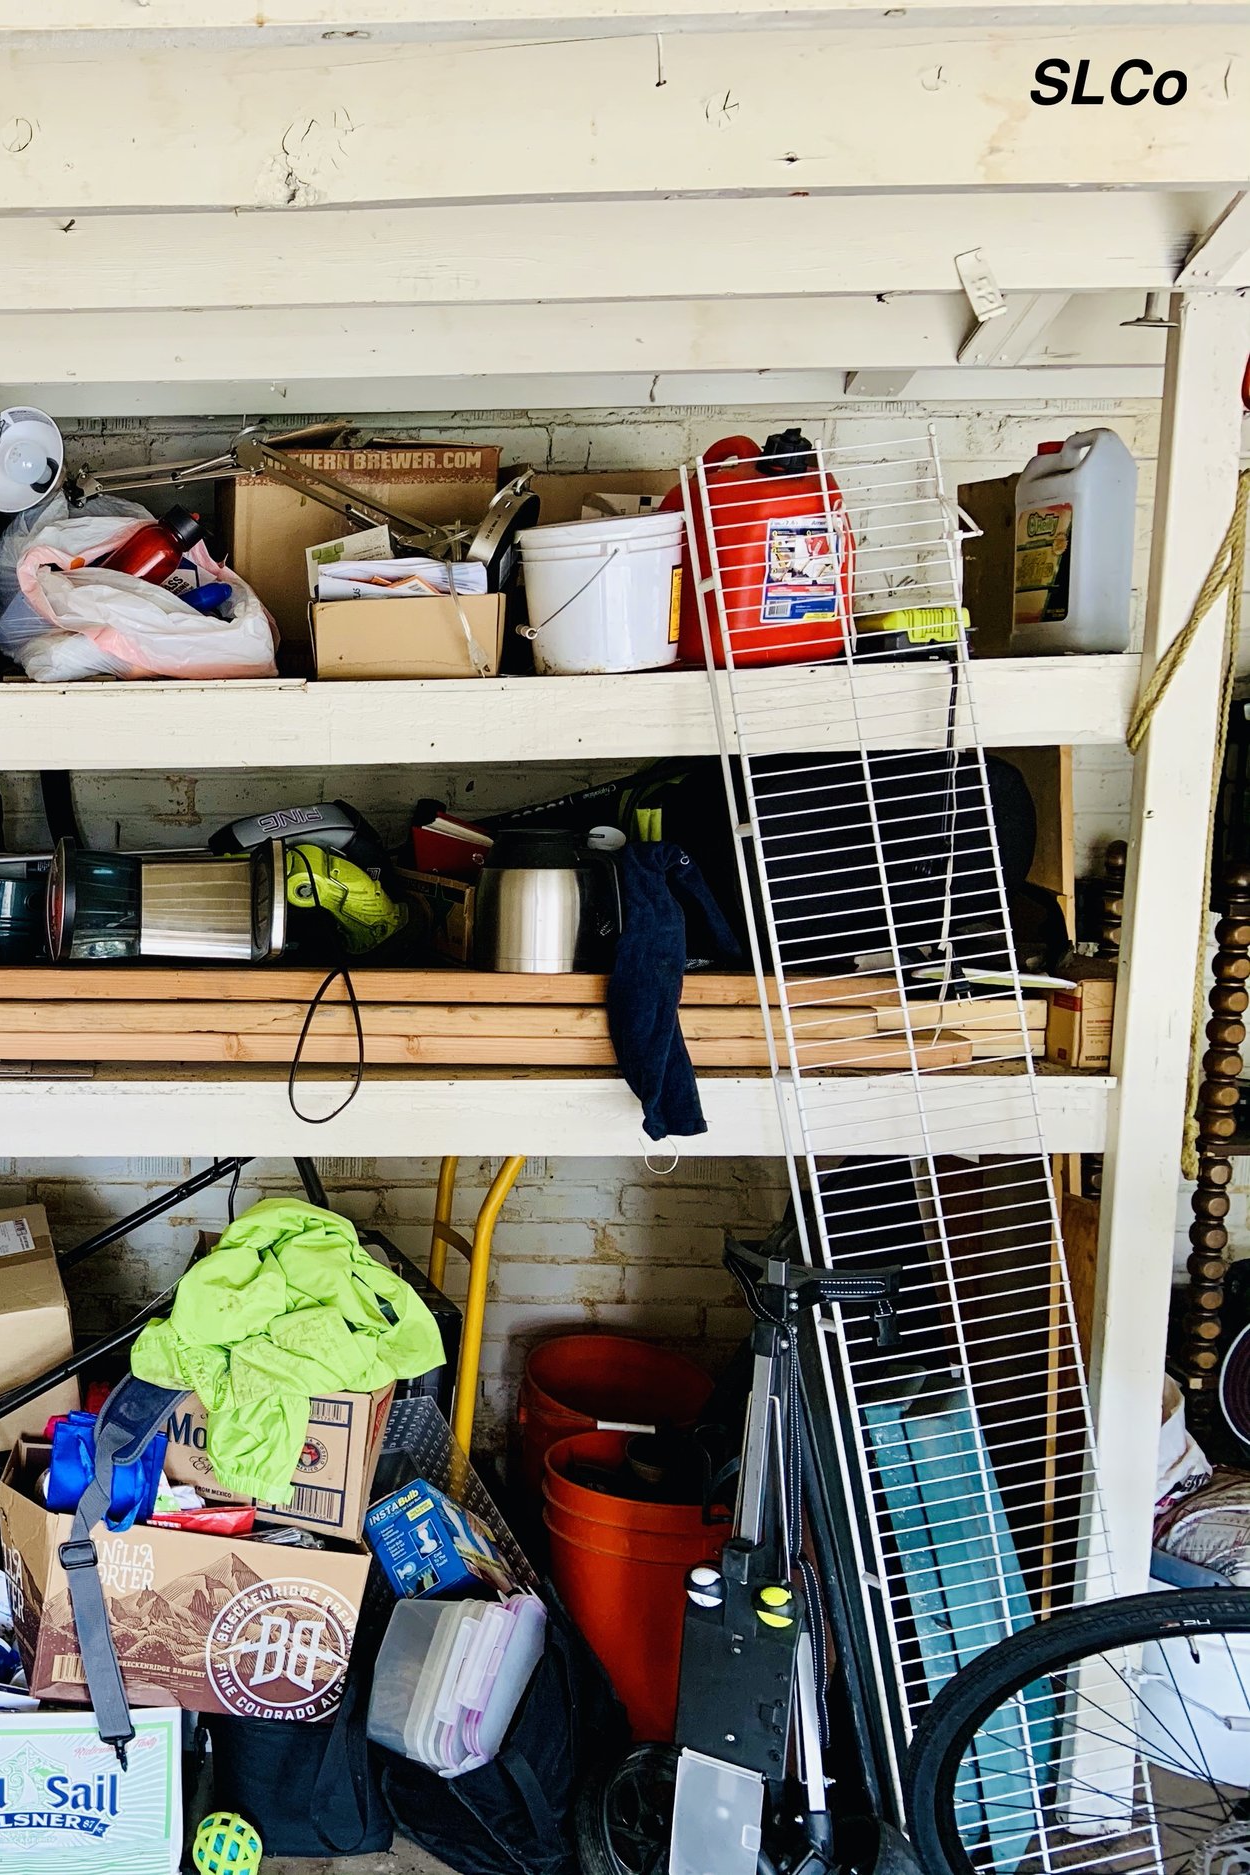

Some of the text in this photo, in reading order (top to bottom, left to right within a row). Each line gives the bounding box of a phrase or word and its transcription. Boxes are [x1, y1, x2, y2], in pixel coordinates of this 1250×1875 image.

[353, 450, 482, 470] BREWER.COM
[258, 806, 323, 833] PING
[167, 1410, 207, 1451] Mo
[195, 1485, 232, 1499] FROM MEXICO
[99, 1563, 155, 1593] ORTER
[217, 1584, 320, 1643] BRECKENRIDGE
[172, 1667, 207, 1679] BREWERY
[214, 1663, 238, 1698] FINE
[236, 1696, 317, 1721] COLORADO
[46, 1773, 122, 1817] Sail
[82, 1819, 95, 1829] 87
